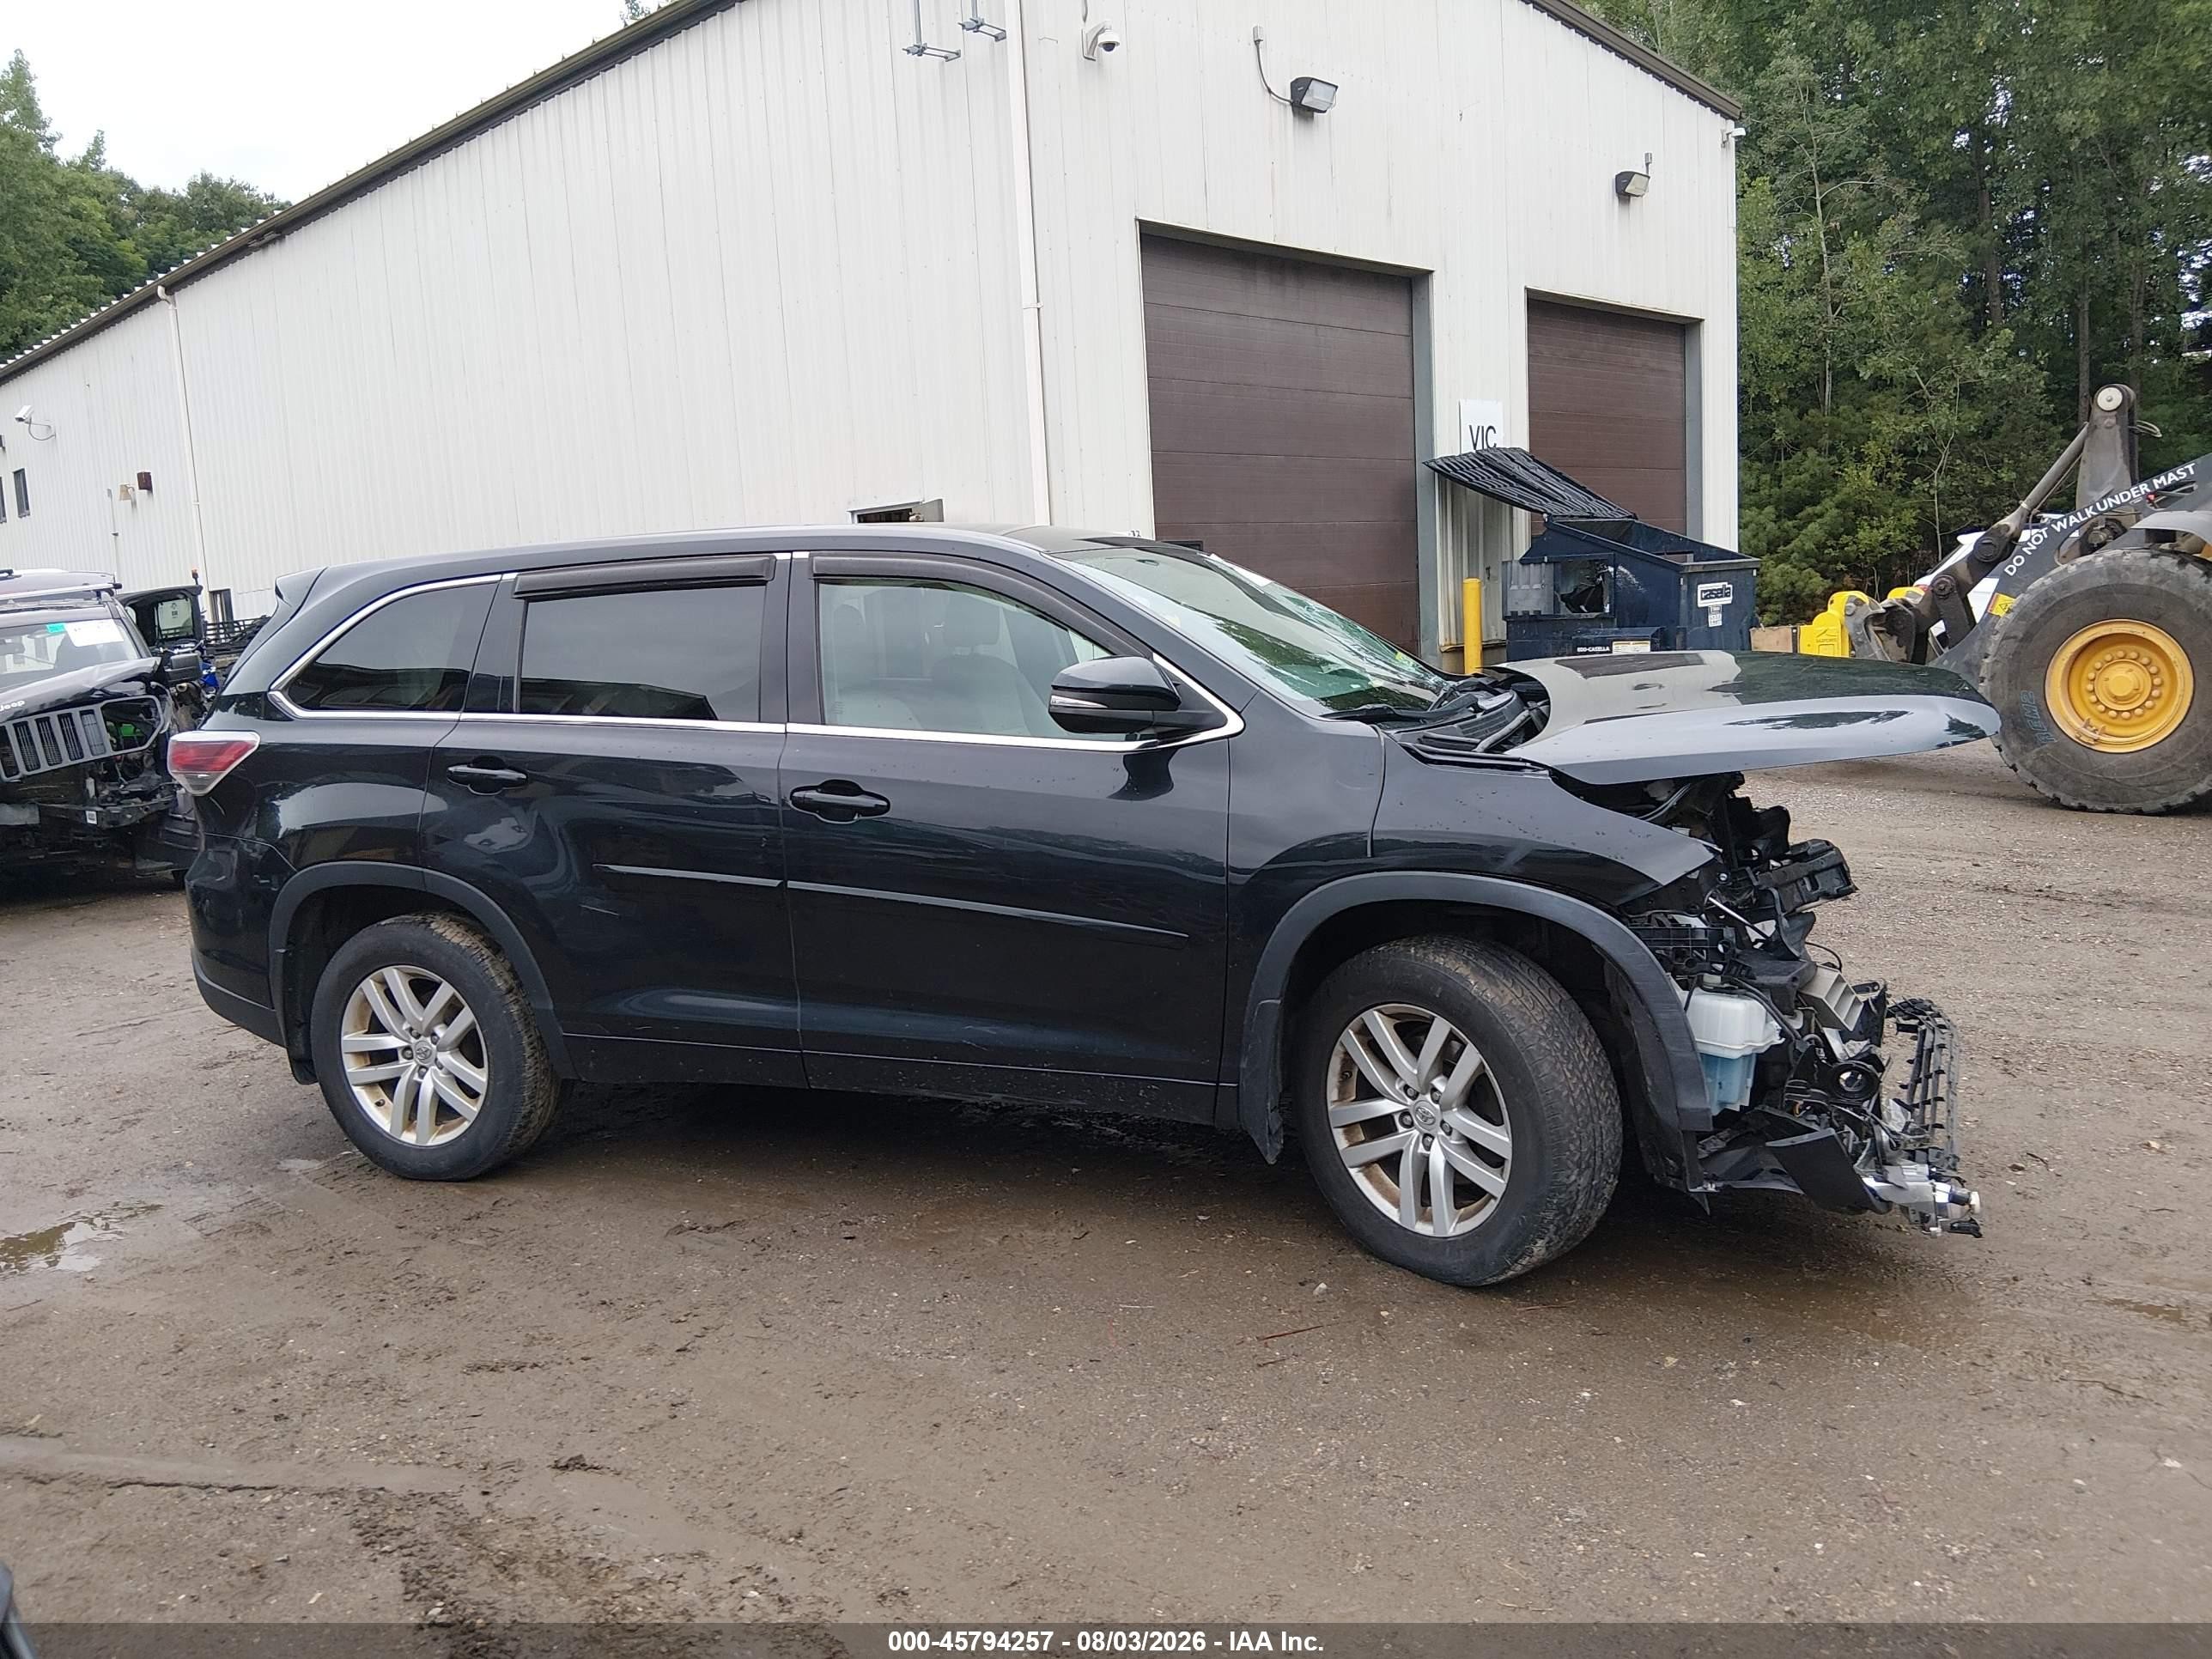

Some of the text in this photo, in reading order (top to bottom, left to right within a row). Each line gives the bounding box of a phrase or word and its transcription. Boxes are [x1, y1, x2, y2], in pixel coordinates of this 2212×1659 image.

[1469, 424, 1497, 450] VIC
[2003, 463, 2196, 576] DO NOT WALK UNDER MAST
